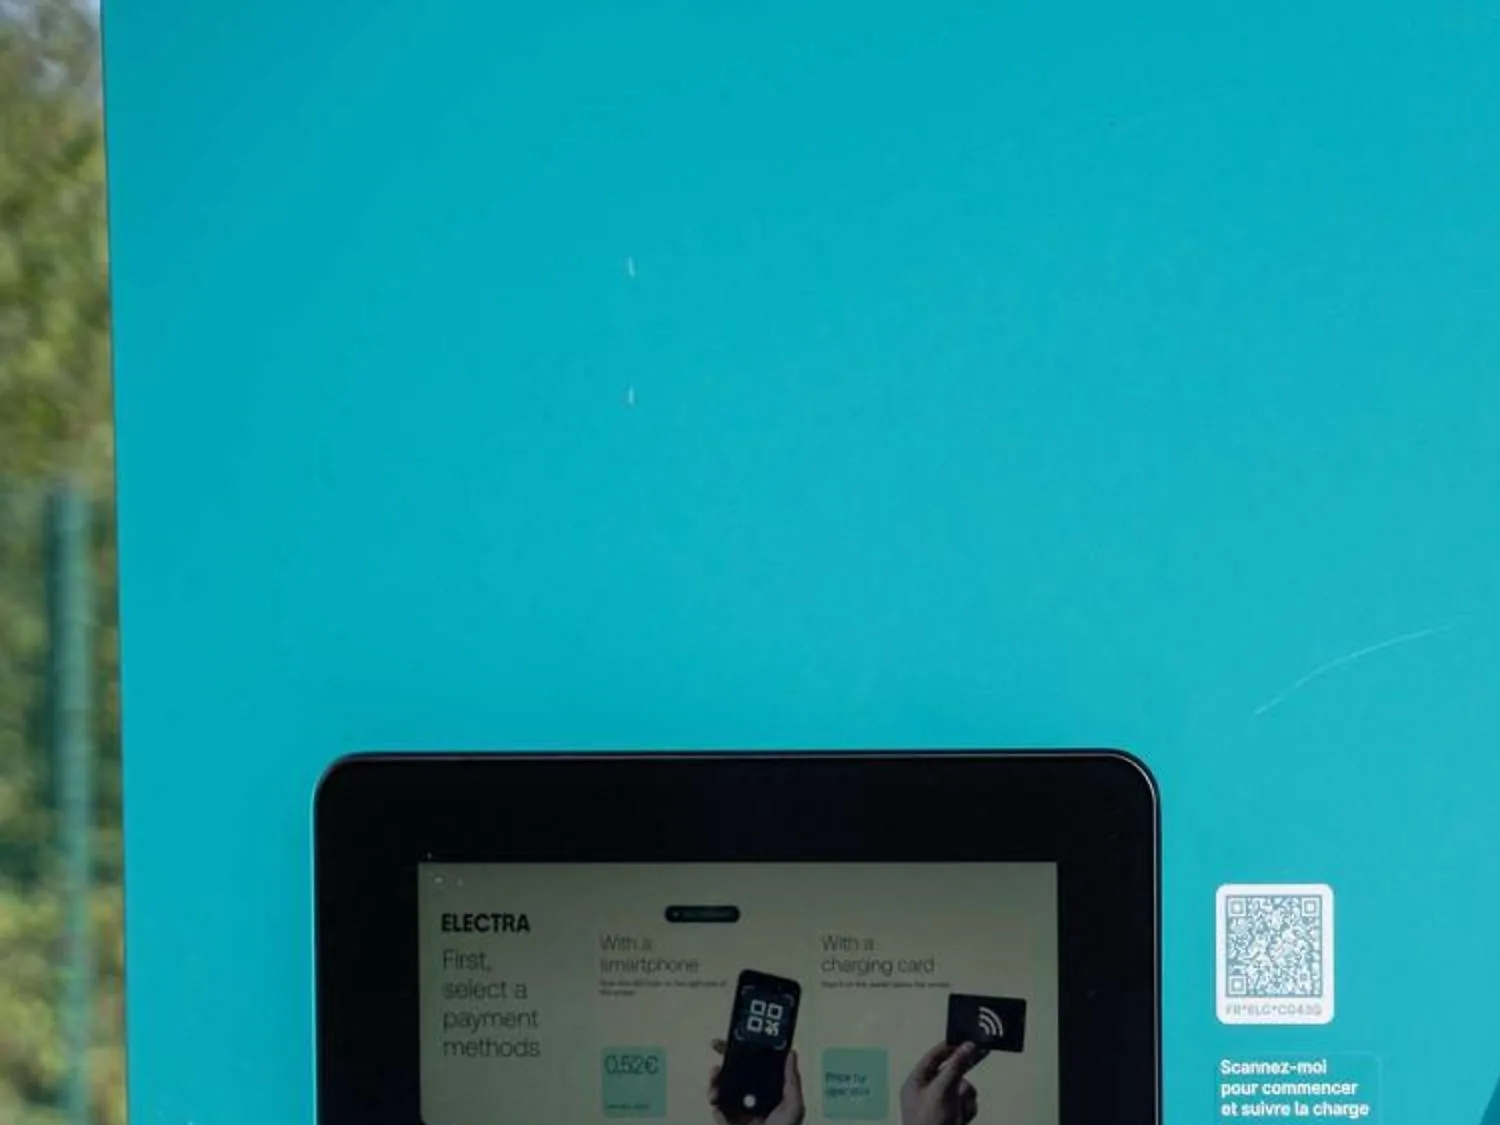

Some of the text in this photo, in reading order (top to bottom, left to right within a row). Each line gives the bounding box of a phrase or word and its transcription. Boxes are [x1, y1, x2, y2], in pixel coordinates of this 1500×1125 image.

[441, 913, 530, 934] ELECTRA
[443, 949, 492, 973] First,
[443, 978, 528, 1000] select a
[443, 1009, 539, 1031] payment
[444, 1037, 541, 1059] methods
[1220, 1059, 1327, 1074] Scannez-moi
[1220, 1081, 1357, 1098] pour commencer
[1221, 1101, 1370, 1118] et suivre la charge
